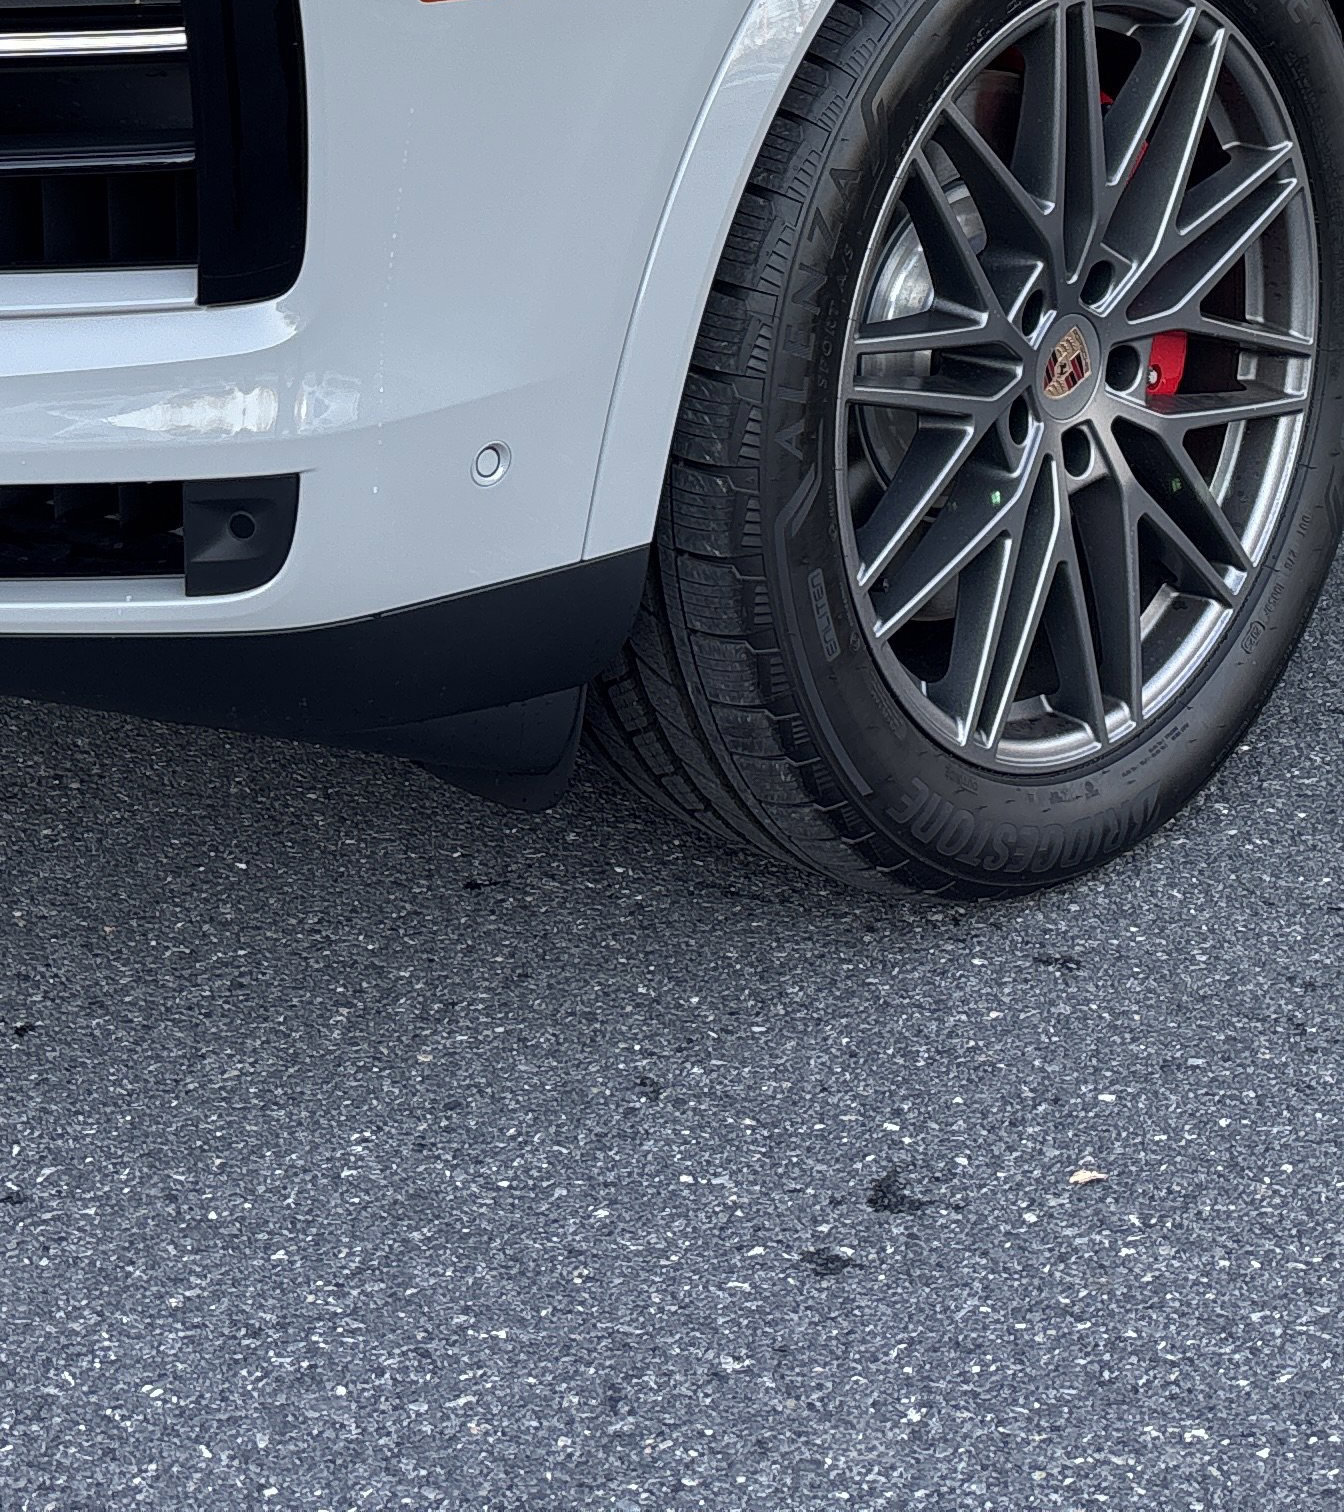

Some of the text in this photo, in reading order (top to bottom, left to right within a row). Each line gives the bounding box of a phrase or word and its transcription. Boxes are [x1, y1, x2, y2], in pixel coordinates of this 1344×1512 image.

[774, 166, 864, 461] ALENZA
[817, 298, 840, 390] SPORT
[810, 571, 838, 657] ENLITEN
[886, 777, 1160, 874] BRIDGESTONE
